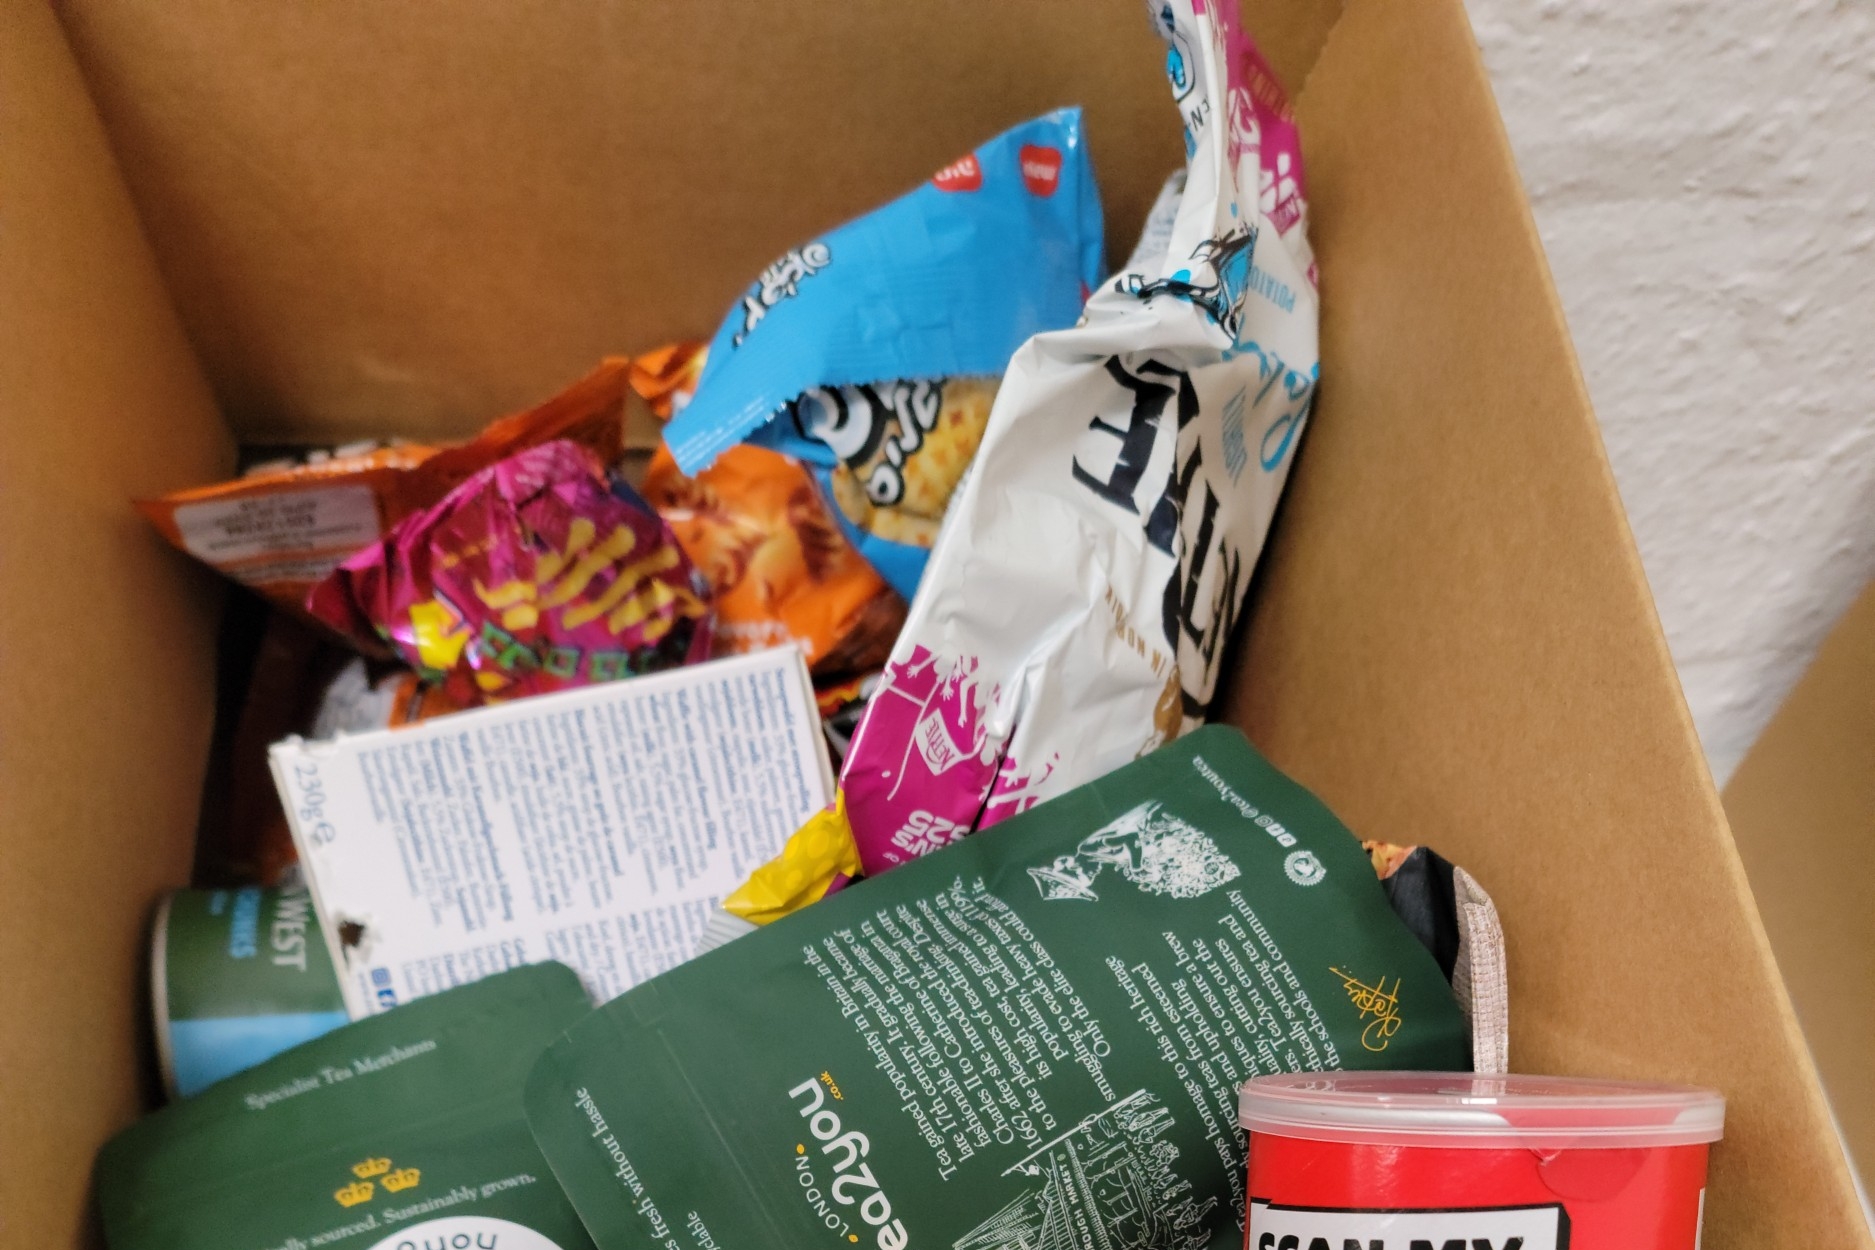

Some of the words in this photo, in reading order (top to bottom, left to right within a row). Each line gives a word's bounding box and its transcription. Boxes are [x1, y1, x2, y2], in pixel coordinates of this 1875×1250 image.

[833, 928, 856, 944] of
[860, 920, 876, 938] in
[876, 909, 904, 939] court
[1217, 913, 1247, 941] and
[1226, 889, 1283, 968] community
[802, 944, 822, 966] the
[822, 931, 859, 981] became
[850, 943, 891, 985] marriage
[870, 934, 911, 981] Braganza
[892, 936, 924, 963] royal
[1241, 939, 1260, 963] tea
[816, 962, 832, 978] in
[898, 975, 921, 990] of
[918, 961, 939, 981] the
[1105, 955, 1146, 1010] heritage
[1272, 961, 1300, 990] and
[826, 975, 860, 1019] Britain
[850, 976, 899, 1035] gradually
[884, 983, 905, 1006] the
[1130, 962, 1181, 1024] esteemed
[1254, 959, 1296, 1020] sourcing
[854, 1013, 871, 1033] in
[915, 989, 962, 1059] Catherine
[927, 978, 986, 1054] introduced
[1137, 1005, 1163, 1036] rich
[1292, 989, 1330, 1041] schools
[886, 1026, 904, 1045] It
[898, 1002, 944, 1069] following
[1157, 1034, 1179, 1063] this
[1176, 1023, 1204, 1061] from
[1288, 1020, 1329, 1079] ethically
[1323, 1041, 1340, 1067] the
[863, 1030, 917, 1101] popularity
[898, 1040, 937, 1097] century.
[958, 1057, 974, 1075] to
[963, 1073, 984, 1092] II
[979, 1051, 1001, 1078] she
[1174, 1062, 1189, 1080] to
[1197, 1060, 1220, 1089] teas
[820, 1070, 844, 1101] .co.uk
[994, 1077, 1021, 1110] after
[574, 1087, 609, 1138] hassle
[900, 1099, 945, 1148] gained
[929, 1095, 958, 1133] 17th
[936, 1066, 992, 1148] fashionable
[977, 1088, 1015, 1145] Charles
[1183, 1078, 1220, 1140] homage
[1201, 1085, 1251, 1149] sourcing
[952, 1131, 975, 1163] late
[1010, 1110, 1043, 1150] 1662
[602, 1133, 644, 1198] without
[936, 1147, 958, 1182] Tea
[1213, 1136, 1237, 1170] pays
[794, 1156, 851, 1239] LONDON
[1059, 1164, 1079, 1205] MARKET
[382, 1183, 479, 1226] Sustainably
[637, 1196, 670, 1239] fresh
